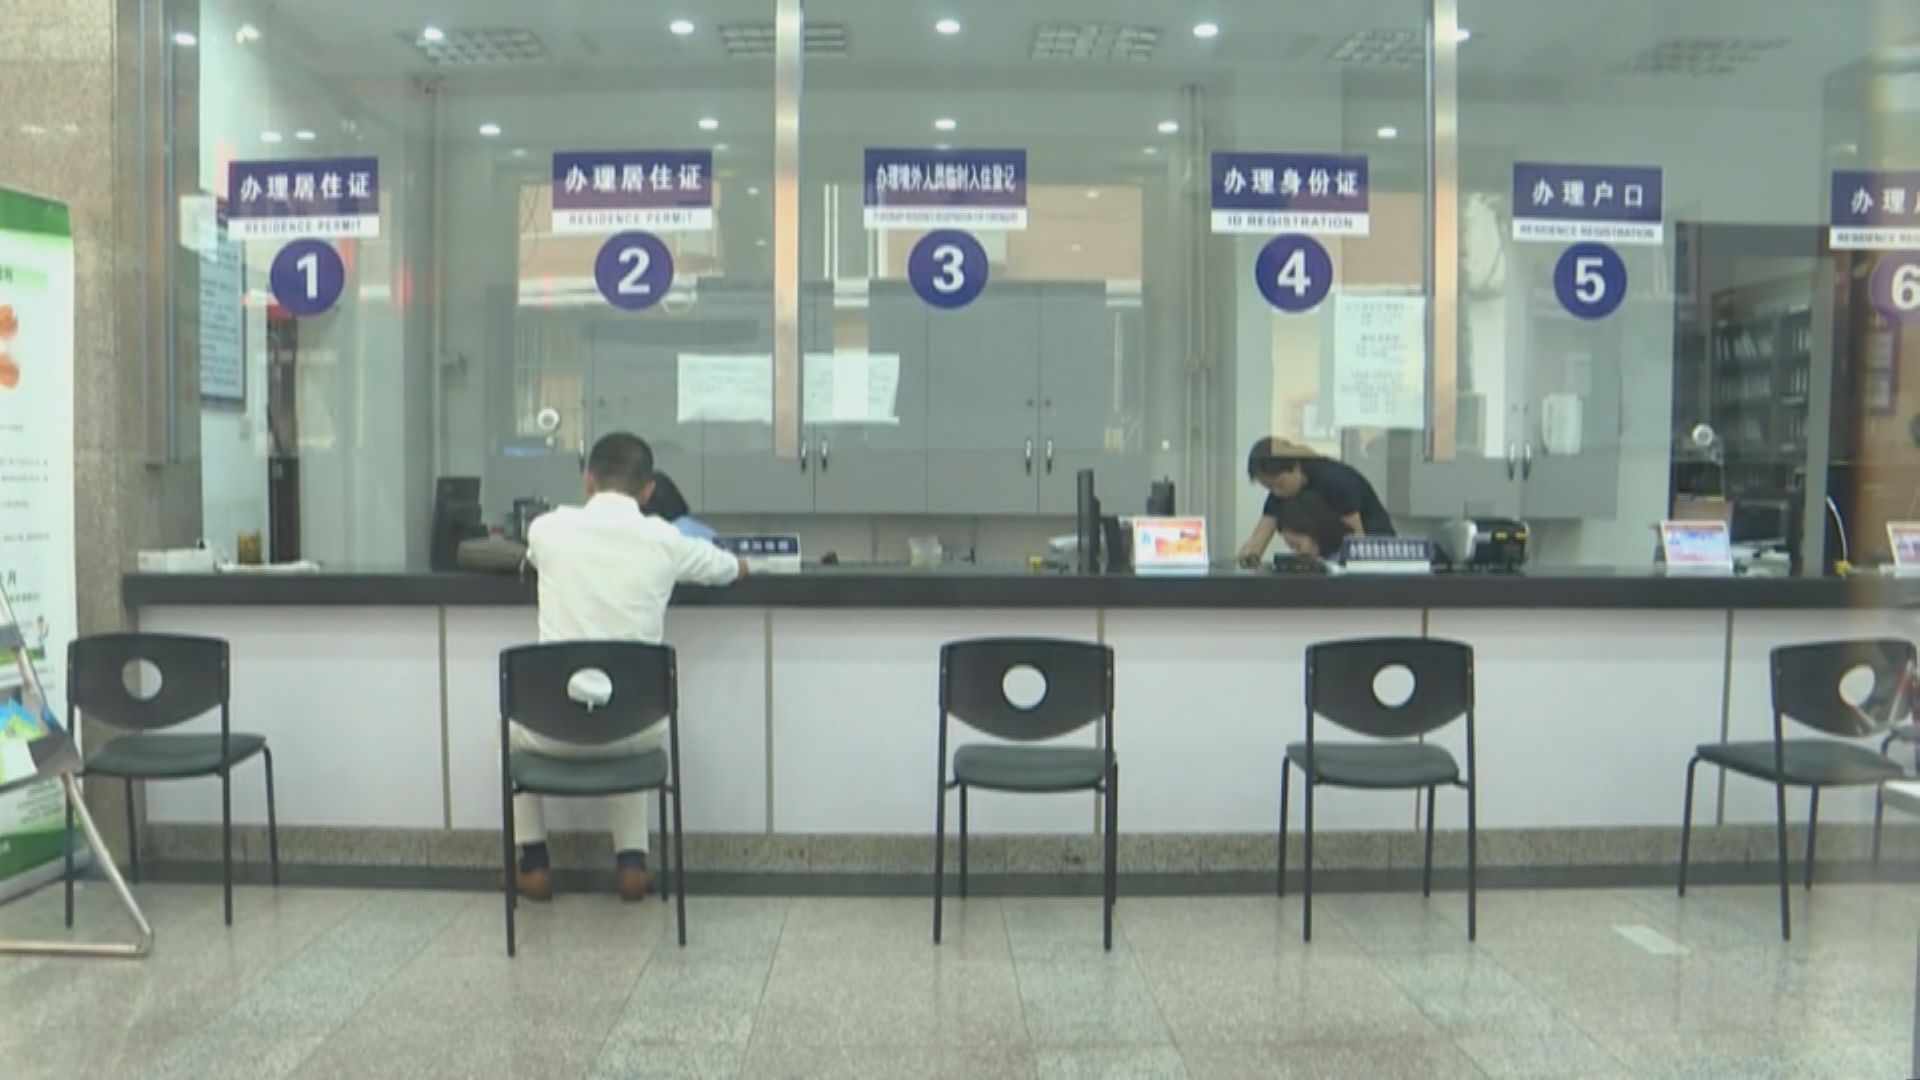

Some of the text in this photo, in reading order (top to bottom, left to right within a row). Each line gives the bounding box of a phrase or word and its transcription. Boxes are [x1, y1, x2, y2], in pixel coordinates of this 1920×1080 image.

[240, 171, 371, 202] 办理居住证
[564, 163, 702, 193] 办理居住证
[1224, 168, 1359, 196] 办理身份证
[1532, 178, 1643, 207] 办理户口
[245, 219, 362, 233] RESIDENCE PERMIT
[569, 212, 693, 225] RESIDENCE PERMIT
[1228, 216, 1353, 229] ID REGISTRATION
[1519, 225, 1654, 238] RESIDENCE REGISTRATION
[1837, 232, 1894, 243] RESIDENCE
[296, 253, 319, 299] 1
[616, 248, 652, 293] 2
[931, 246, 965, 293] 3
[1277, 249, 1311, 296] 4
[1575, 257, 1606, 303] 5
[1891, 264, 1920, 310] 6
